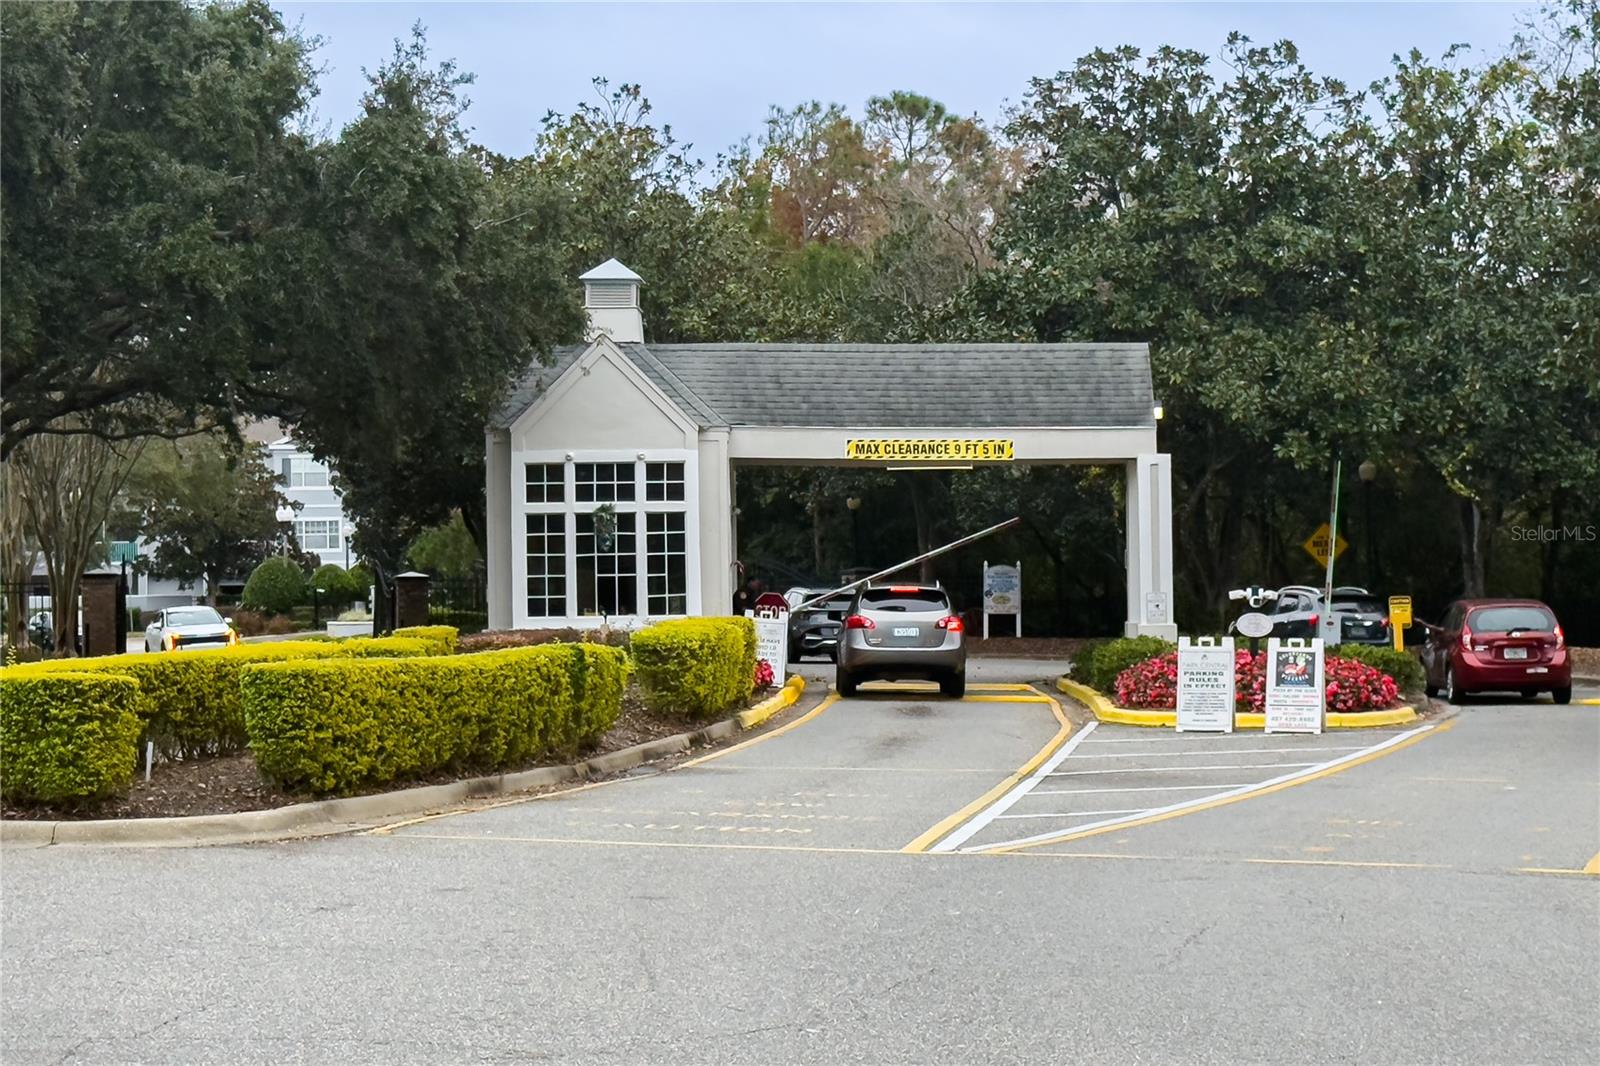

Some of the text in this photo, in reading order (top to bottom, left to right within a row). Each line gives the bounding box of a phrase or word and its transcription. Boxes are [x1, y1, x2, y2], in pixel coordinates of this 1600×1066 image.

[855, 443, 1005, 455] MAX CLEARANCE 9 FT 5 IN
